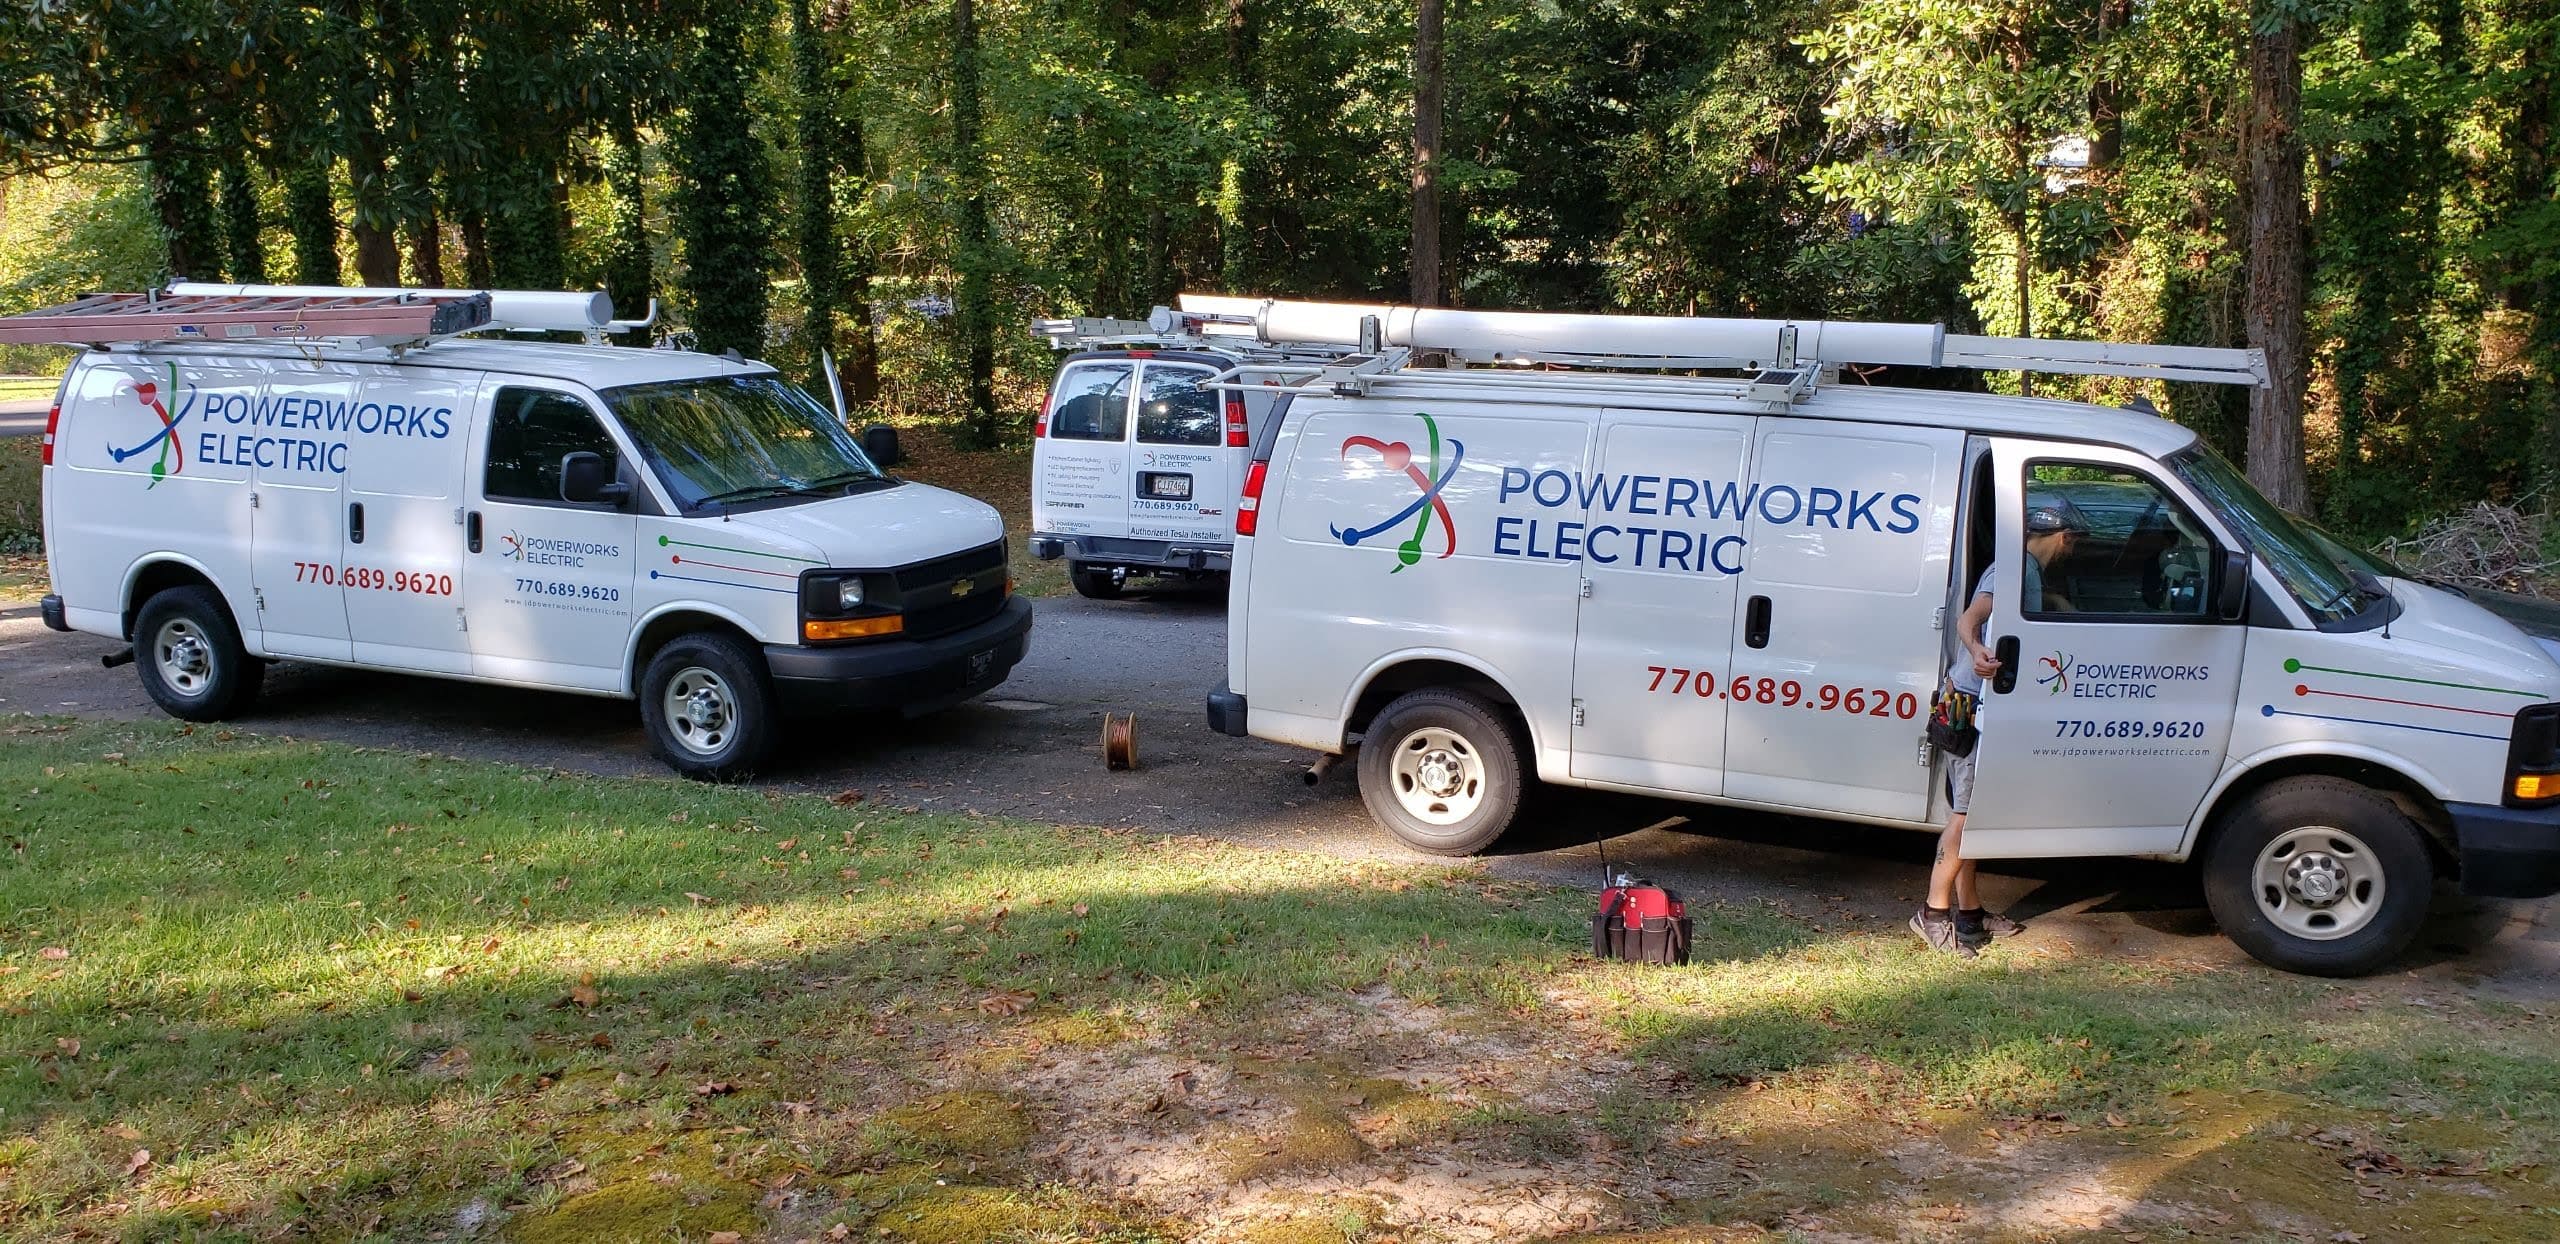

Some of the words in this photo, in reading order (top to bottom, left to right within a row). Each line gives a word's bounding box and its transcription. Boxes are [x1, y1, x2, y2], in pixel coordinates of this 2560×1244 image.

[202, 393, 453, 439] POWERWORKS
[198, 432, 349, 474] ELECTRIC
[1158, 453, 1212, 463] POWERWORKS
[1159, 460, 1193, 468] ELECTRIC
[1133, 500, 1199, 511] 770.689.9620
[1498, 466, 1923, 536] POWERWORKS
[1130, 526, 1169, 537] Authorized
[1171, 529, 1189, 538] Tesla
[1190, 530, 1222, 540] Installer
[527, 537, 620, 558] POWERWORKS
[1494, 516, 1748, 576] ELECTRIC
[527, 551, 585, 569] ELECTRIC
[293, 561, 453, 597] 770.689.9620
[515, 578, 620, 602] 770.689.9620
[2075, 664, 2209, 681] POWERWORKS
[1646, 666, 1918, 721] 770.689.9620
[2073, 683, 2158, 699] ELECTRIC
[2055, 720, 2205, 738] 770.689.9620
[2032, 747, 2211, 758] www.jdpowerworkselectric.com
